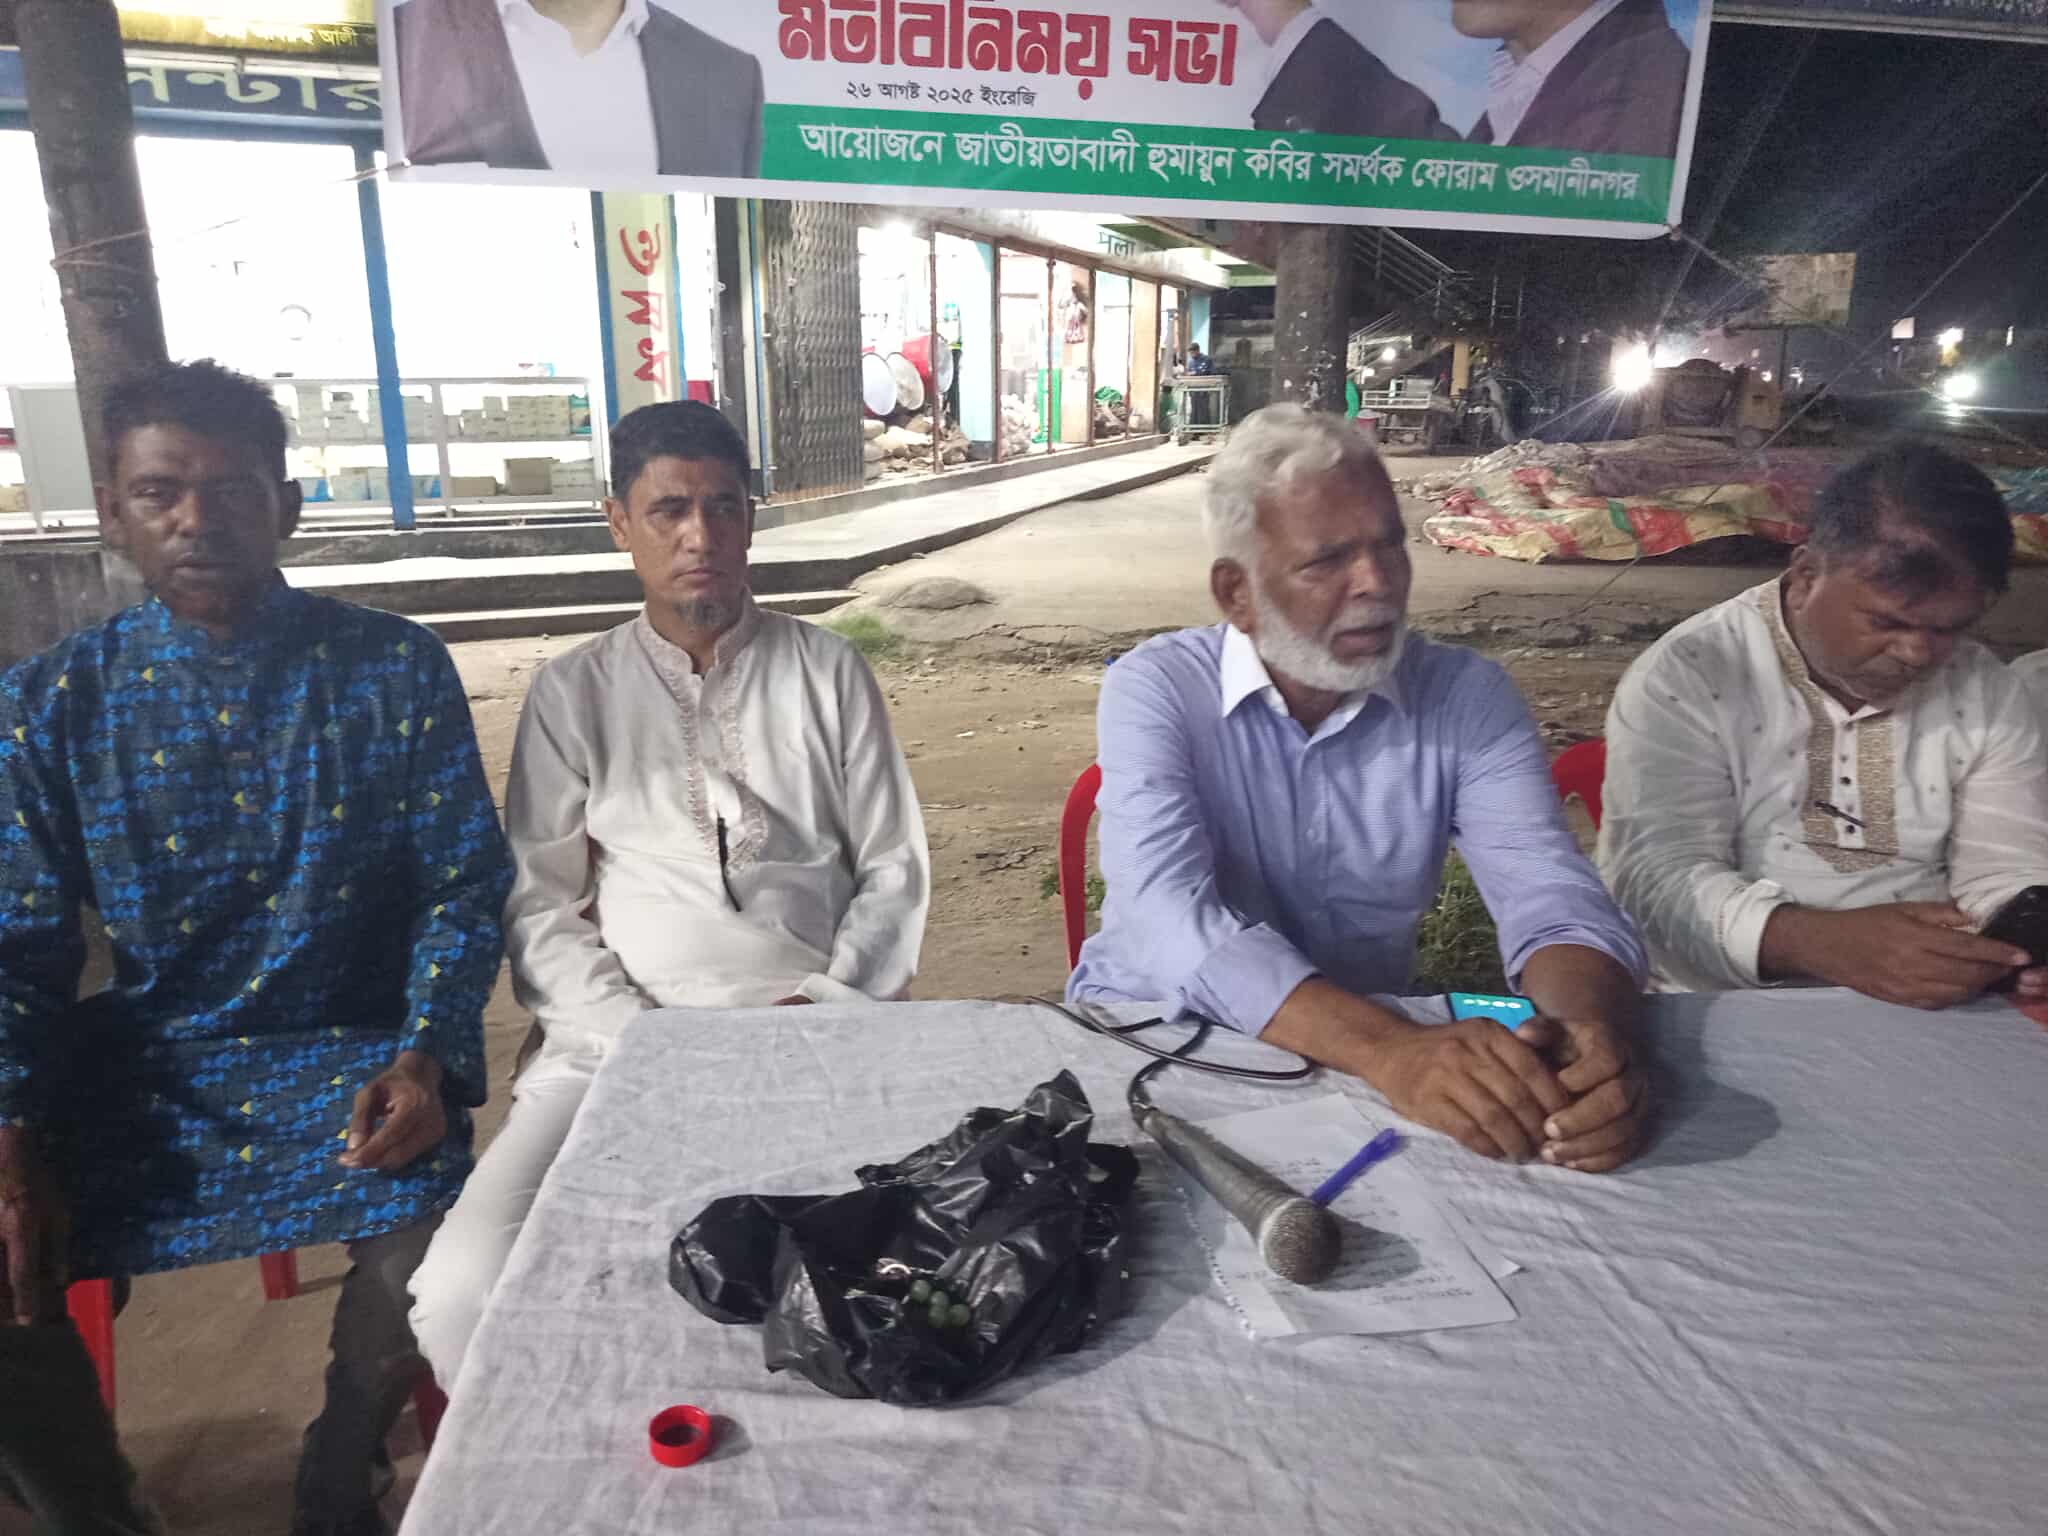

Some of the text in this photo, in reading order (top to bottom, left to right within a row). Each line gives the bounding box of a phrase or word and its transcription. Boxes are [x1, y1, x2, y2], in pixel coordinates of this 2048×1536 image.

[1128, 17, 1238, 86] সভা
[846, 80, 1037, 107] ২৬ আগষ্ট ২০২৫ ইংরেজি
[798, 122, 1640, 202] আয়োজনে জাতীয়তাবাদী হুমায়ুন কবির সমর্থক ফোরাম ওসমানীনগর
